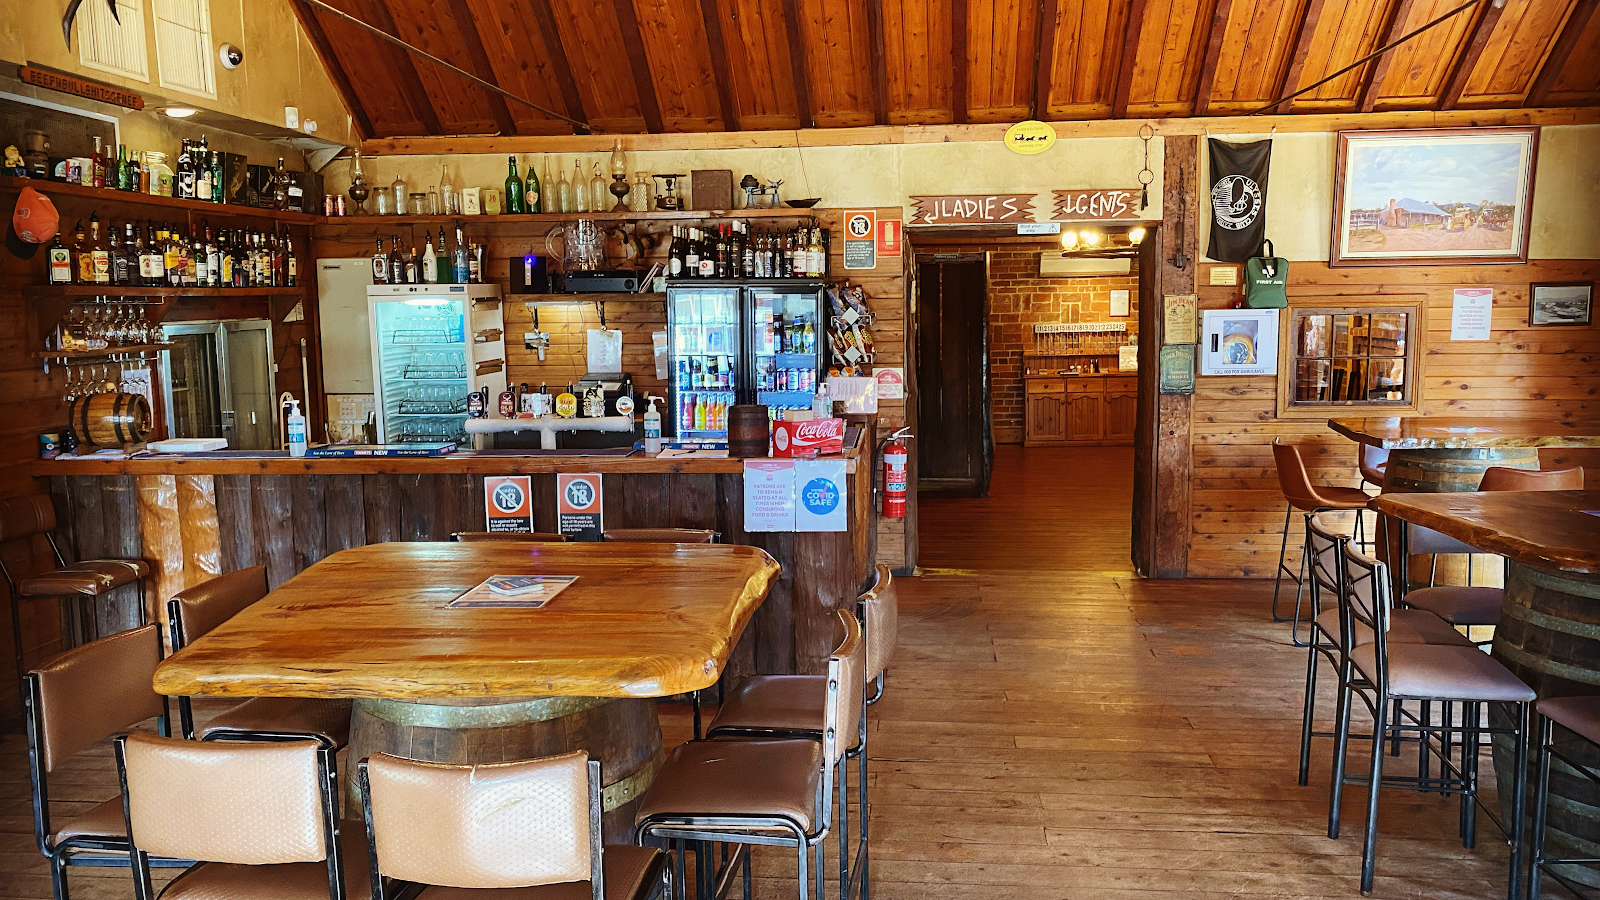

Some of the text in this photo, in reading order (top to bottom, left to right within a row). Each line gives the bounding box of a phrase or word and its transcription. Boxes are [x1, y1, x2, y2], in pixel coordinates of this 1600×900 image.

[942, 197, 1017, 220] LADIES
[1076, 191, 1130, 217] GENTS
[796, 420, 839, 440] Coca-Cola
[500, 493, 516, 508] 18
[572, 490, 587, 504] 18
